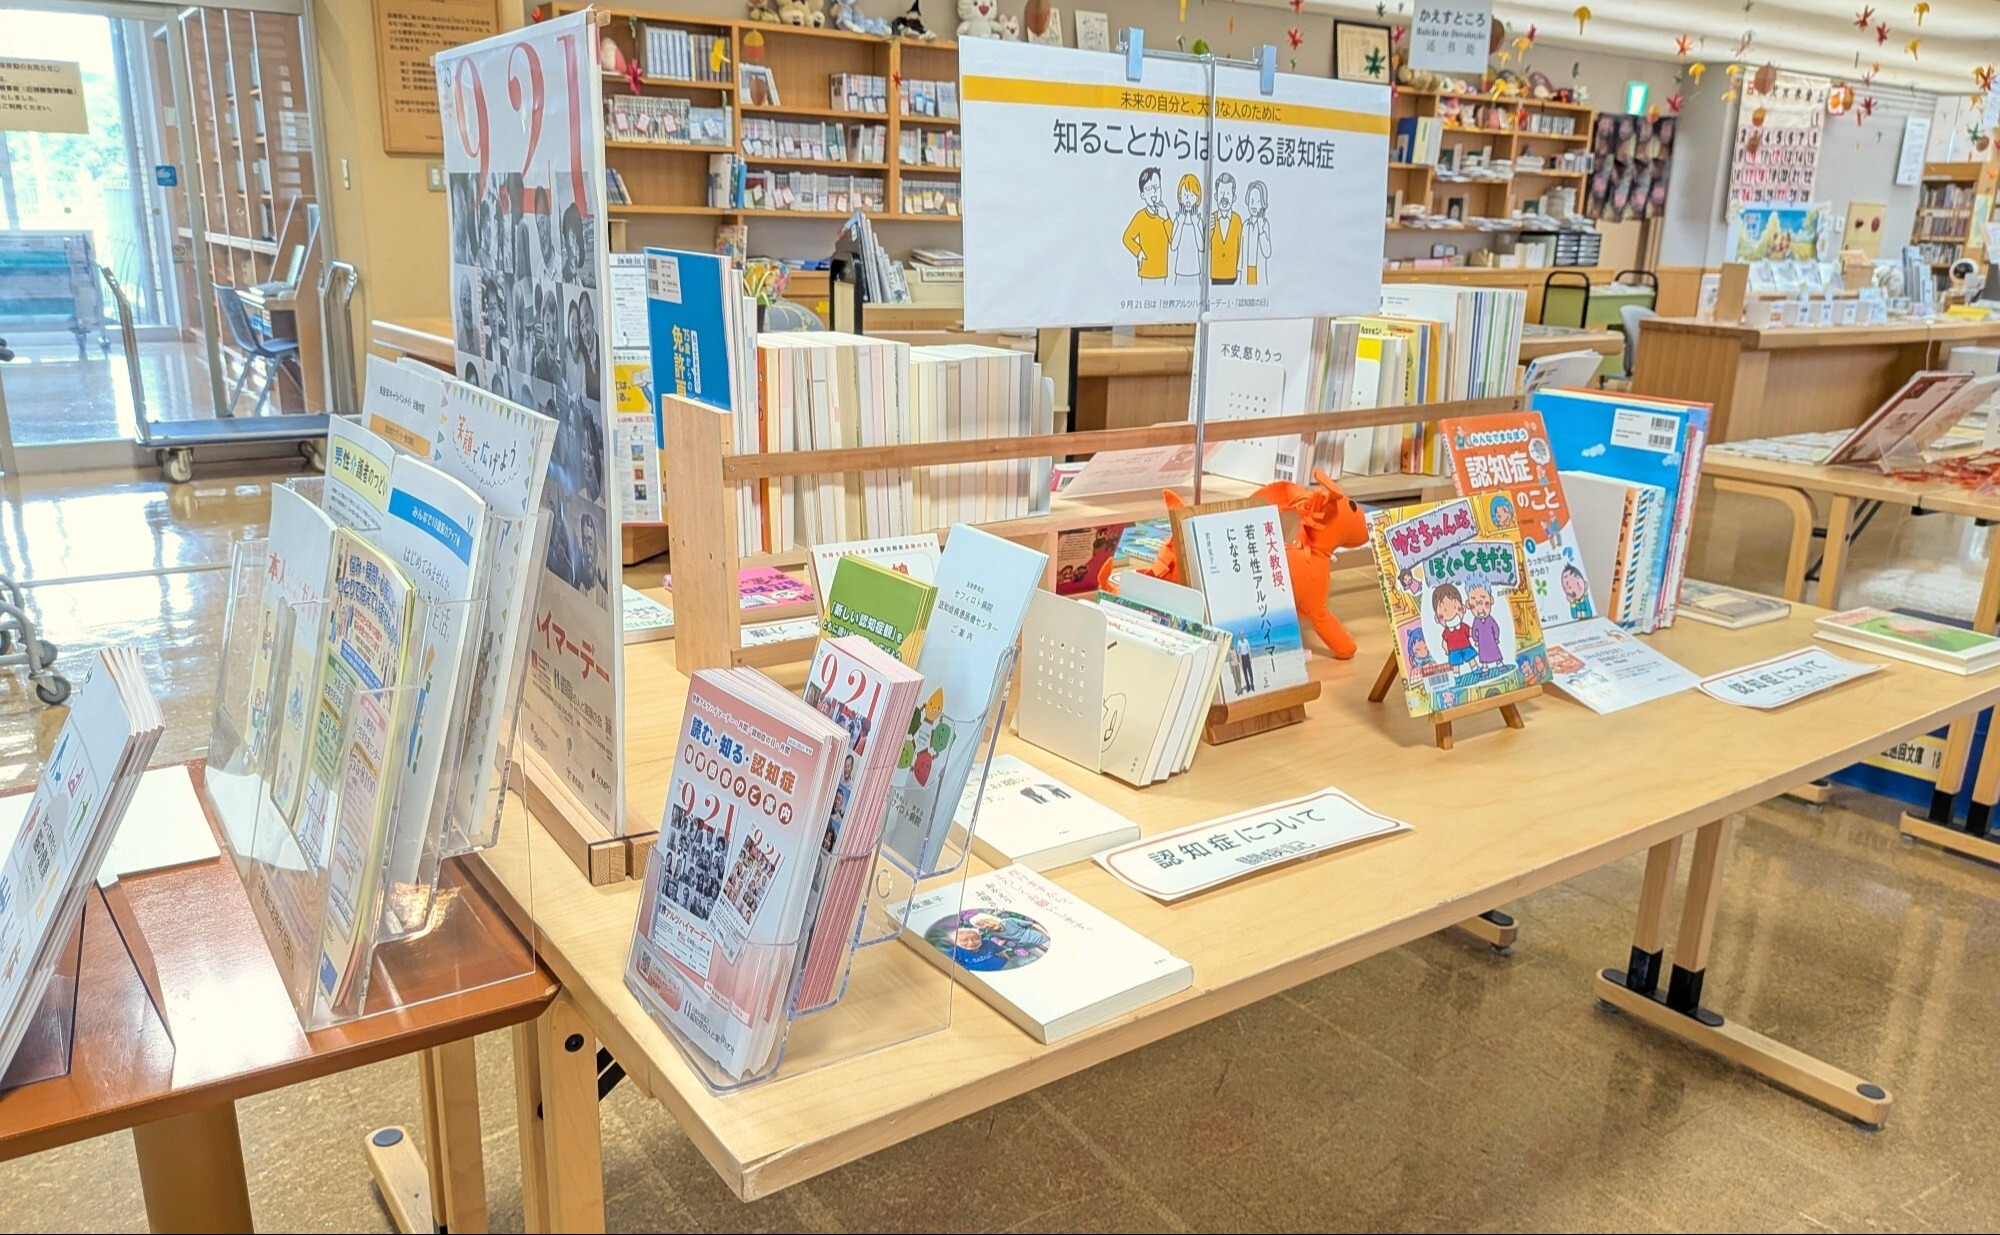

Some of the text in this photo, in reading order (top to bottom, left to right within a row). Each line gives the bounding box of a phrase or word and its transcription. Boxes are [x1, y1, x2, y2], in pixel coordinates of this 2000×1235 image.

[1419, 8, 1486, 27] かえすところ
[1053, 118, 1335, 170] 知ることからはじめる認知症
[1463, 451, 1534, 490] 認知症
[1516, 488, 1561, 511] のこと
[1225, 527, 1241, 574] になる
[1262, 520, 1286, 592] 東大教授、
[1391, 507, 1472, 556] ゆきちゃんは
[1243, 523, 1276, 673] 若年性アルツハイマー
[1147, 808, 1326, 869] 認知症について
